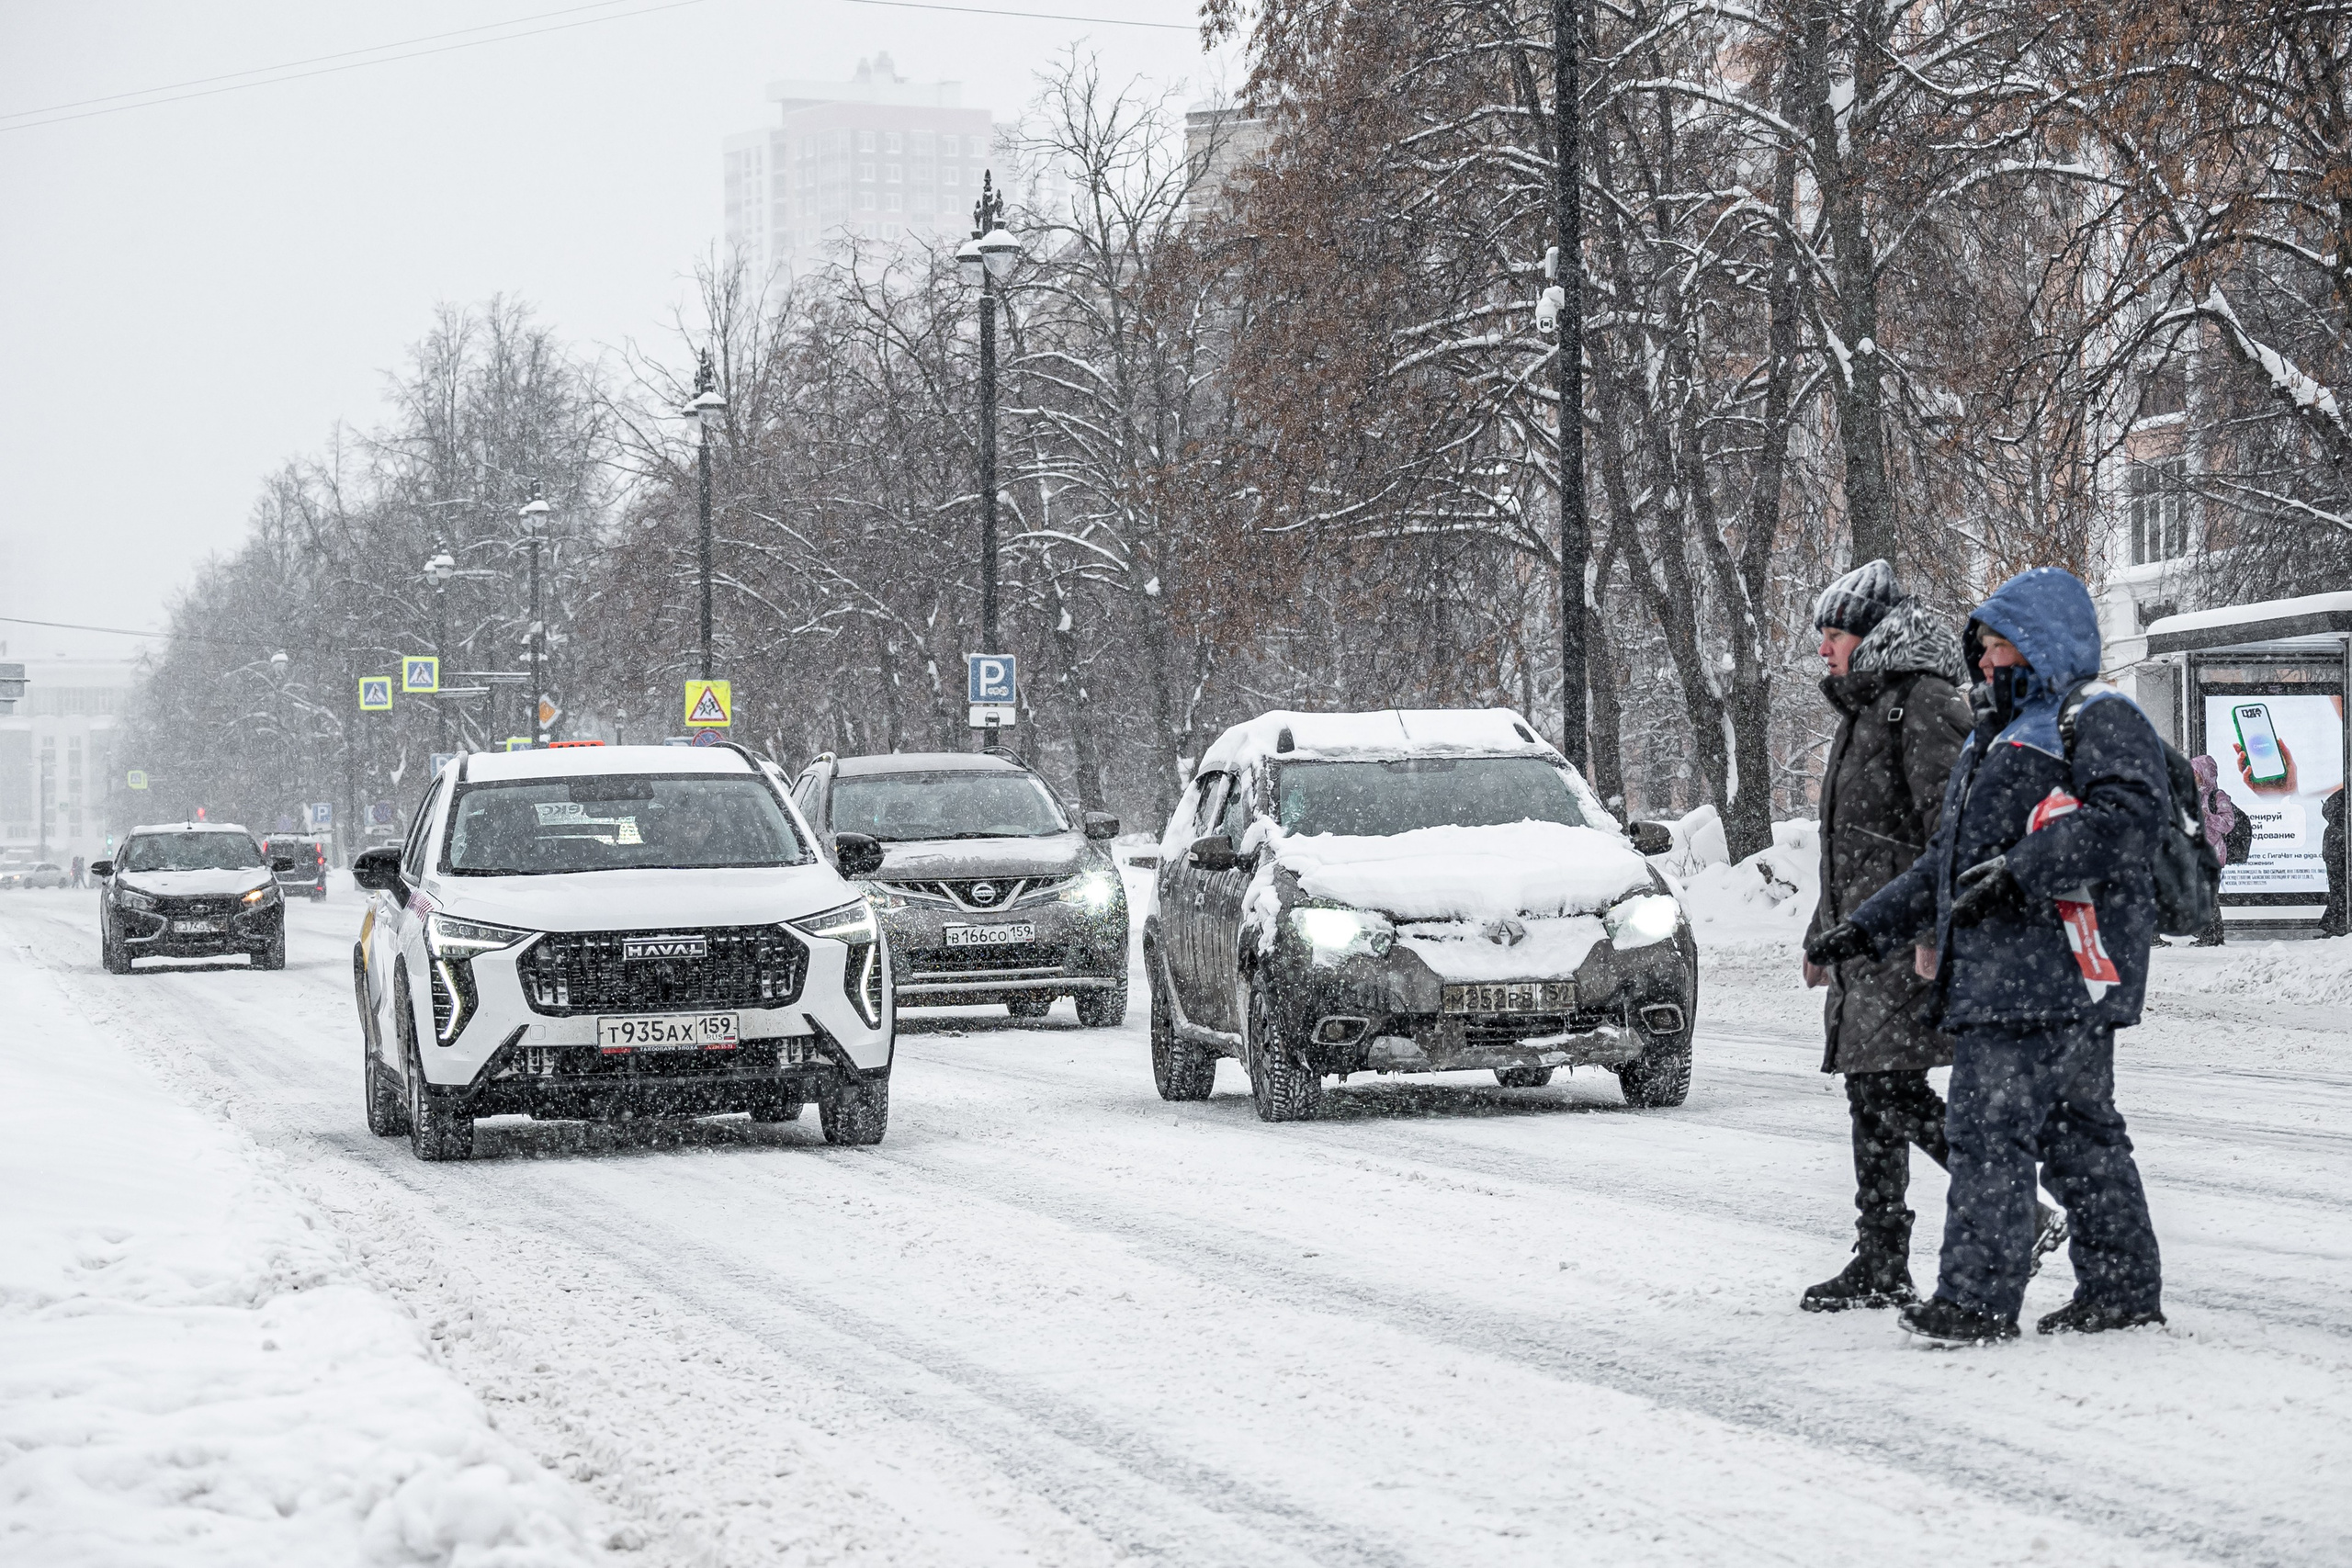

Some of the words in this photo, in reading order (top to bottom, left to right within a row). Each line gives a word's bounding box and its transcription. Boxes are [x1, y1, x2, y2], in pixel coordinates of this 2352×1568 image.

[979, 660, 1005, 696] P
[2248, 812, 2282, 822] енируй
[951, 929, 1007, 944] В166СО
[1010, 925, 1031, 937] 159
[628, 943, 704, 957] HAVAL
[607, 1021, 694, 1043] Т935АХ
[698, 1017, 731, 1034] 159
